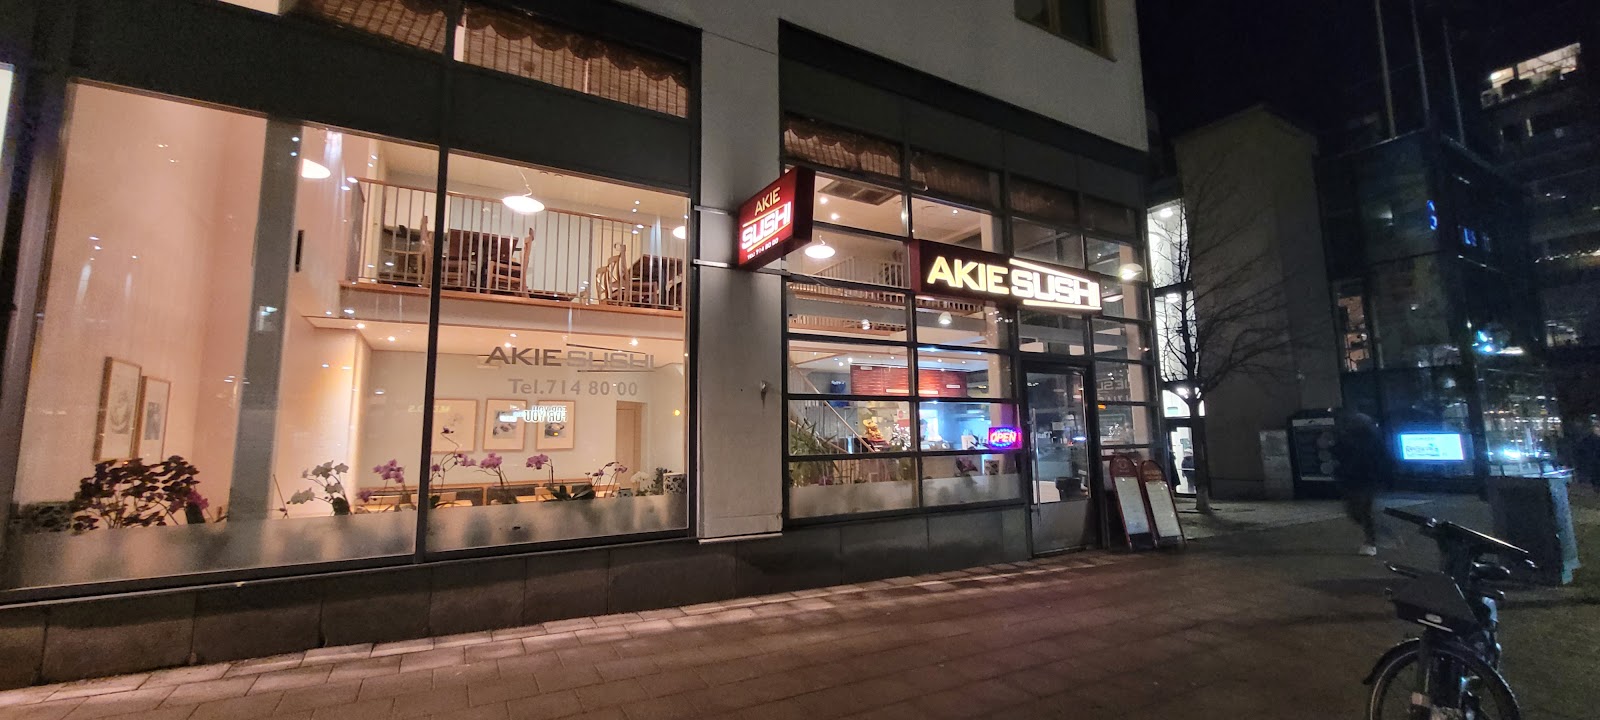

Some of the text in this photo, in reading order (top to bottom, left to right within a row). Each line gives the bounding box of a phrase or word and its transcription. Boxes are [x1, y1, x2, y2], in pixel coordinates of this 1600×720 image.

[755, 187, 781, 215] AKIE
[741, 201, 791, 249] SUSHI
[927, 256, 1102, 307] AKIE SUSHI
[485, 346, 655, 369] AKIE SUSHI
[588, 381, 610, 396] 80
[617, 381, 638, 396] 00
[991, 430, 1017, 444] OPEN
